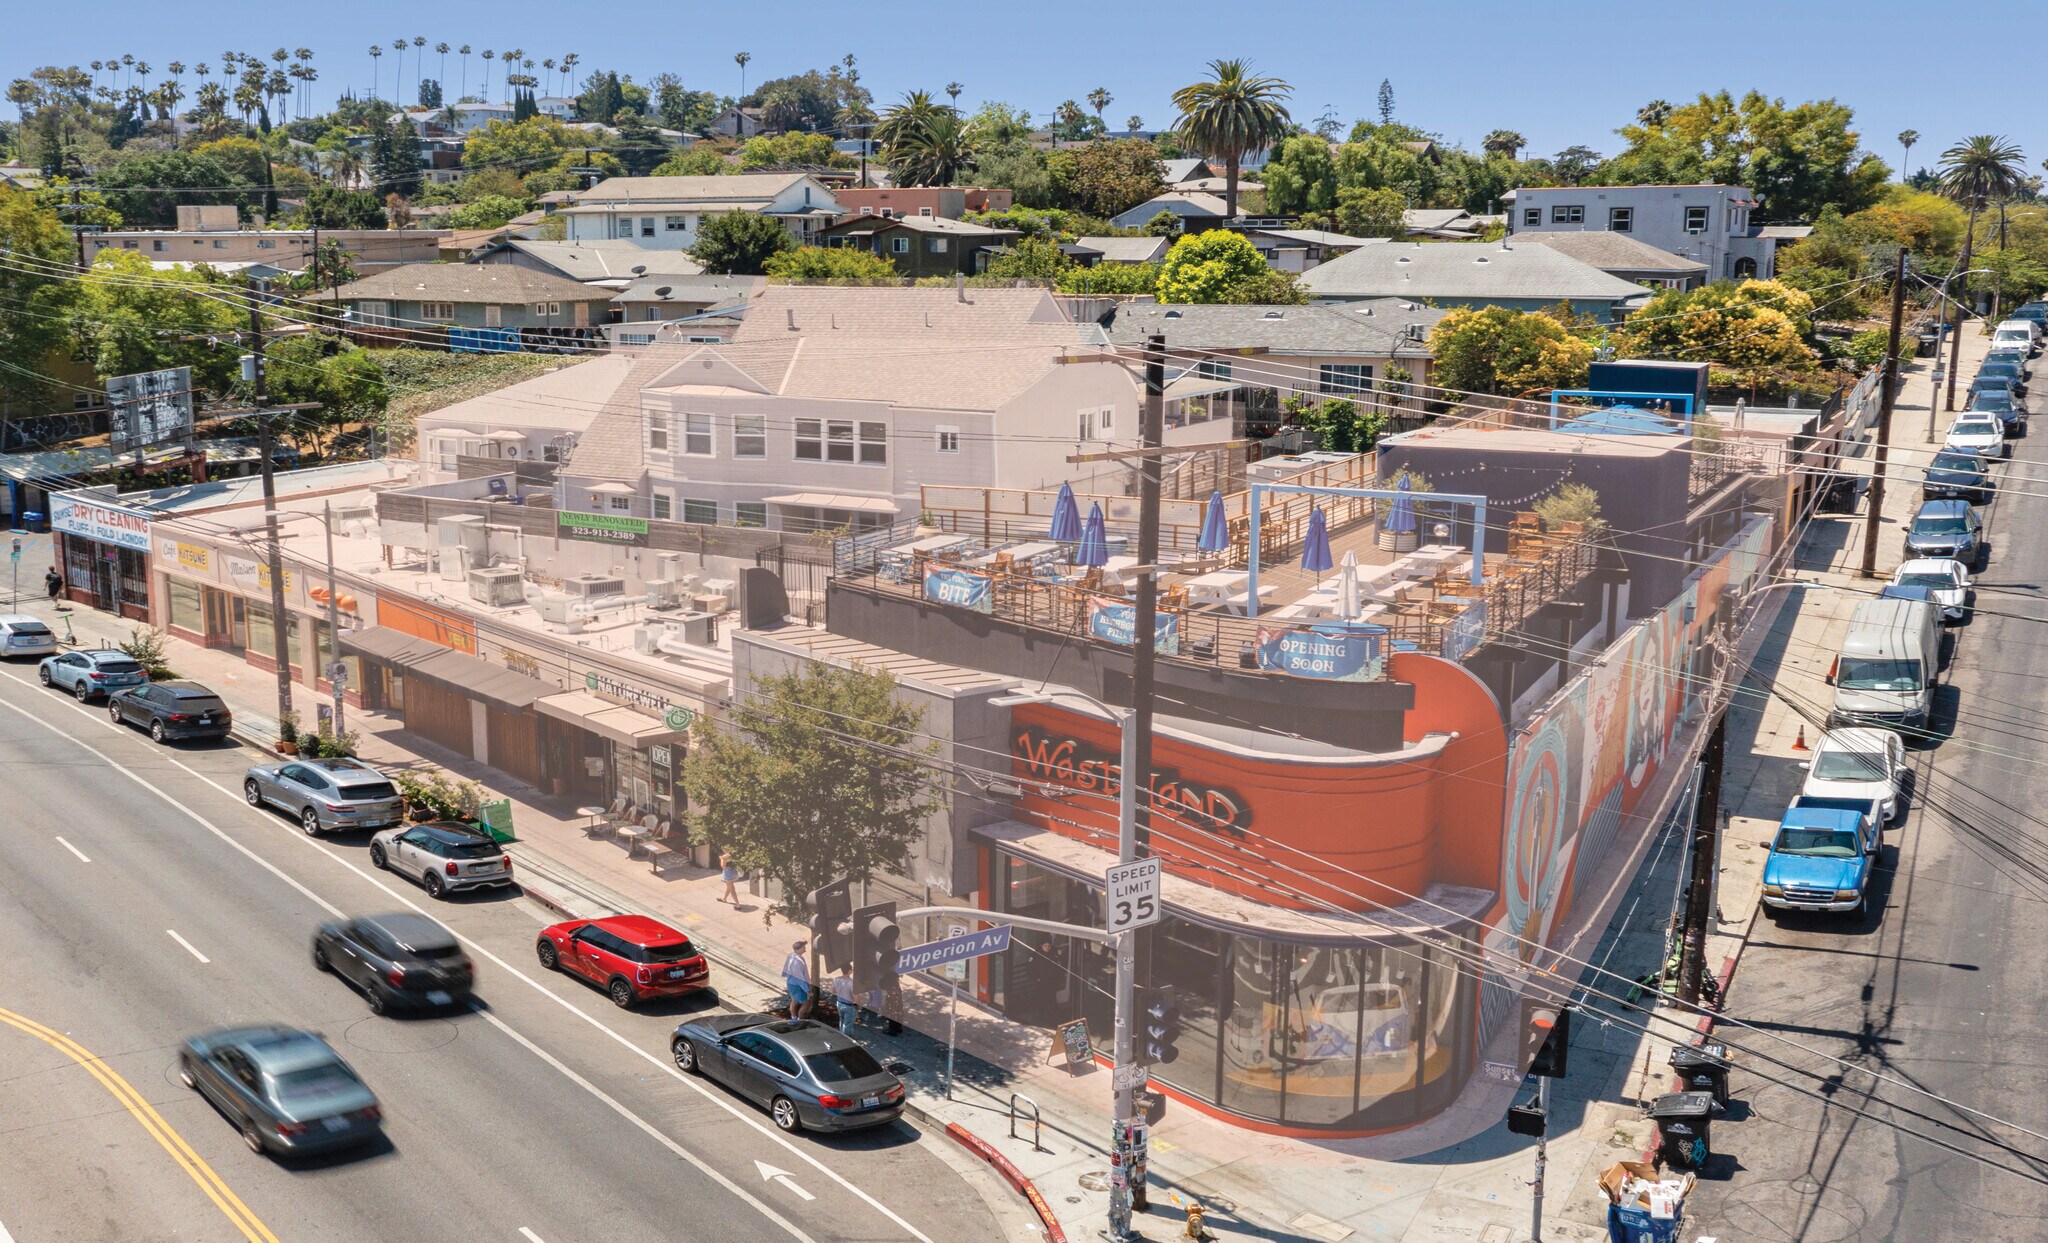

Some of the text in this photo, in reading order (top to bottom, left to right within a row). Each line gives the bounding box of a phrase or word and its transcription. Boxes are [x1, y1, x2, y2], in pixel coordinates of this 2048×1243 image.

[73, 504, 148, 533] DRY CLEANING
[562, 512, 591, 522] NEWLY
[69, 520, 89, 532] FLUFF
[97, 526, 115, 539] FOLD
[572, 527, 635, 540] 323-913-2389
[230, 561, 257, 577] Maison
[938, 582, 971, 606] BITE
[1121, 609, 1136, 621] YOU
[1280, 640, 1346, 657] OPENING
[1291, 657, 1335, 673] SOON
[654, 748, 671, 765] OPEN
[1111, 864, 1156, 883] SPEED
[1116, 880, 1151, 897] LIMIT
[1114, 894, 1154, 925] 35
[899, 940, 976, 968] Hyperion
[981, 934, 1002, 949] Av
[1485, 1063, 1515, 1077] Sunset
